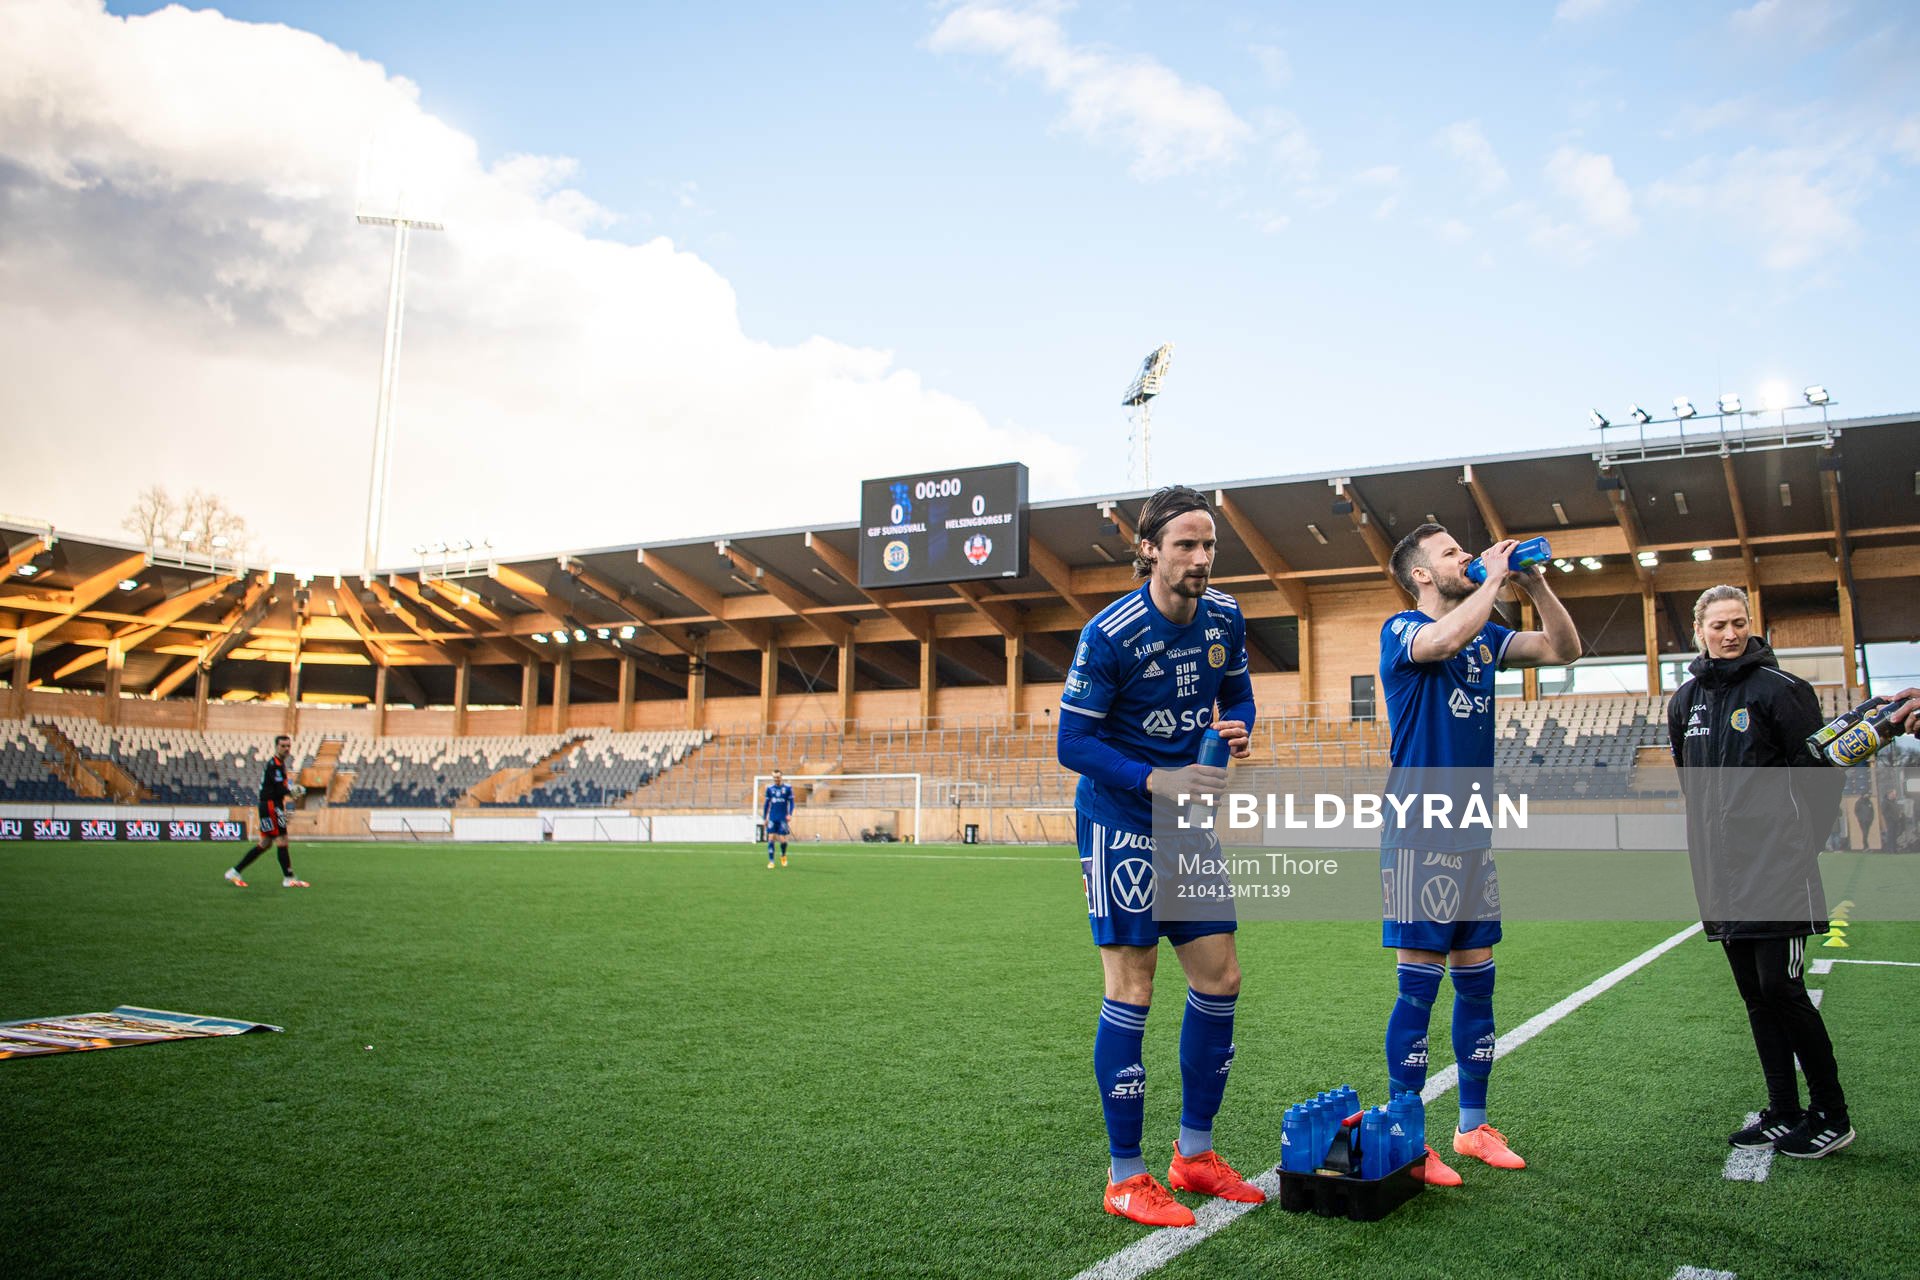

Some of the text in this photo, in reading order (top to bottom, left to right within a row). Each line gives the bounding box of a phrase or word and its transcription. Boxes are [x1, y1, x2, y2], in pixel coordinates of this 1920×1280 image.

[915, 478, 961, 500] 00:00
[971, 495, 985, 516] 0
[891, 504, 904, 524] 0
[945, 514, 1012, 530] HELSINGBORGS IF
[867, 523, 927, 537] GIF SUNDSVALL
[1204, 627, 1221, 641] NP3
[1143, 669, 1165, 679] adidas
[1176, 685, 1198, 698] ALL
[1181, 708, 1211, 732] SC
